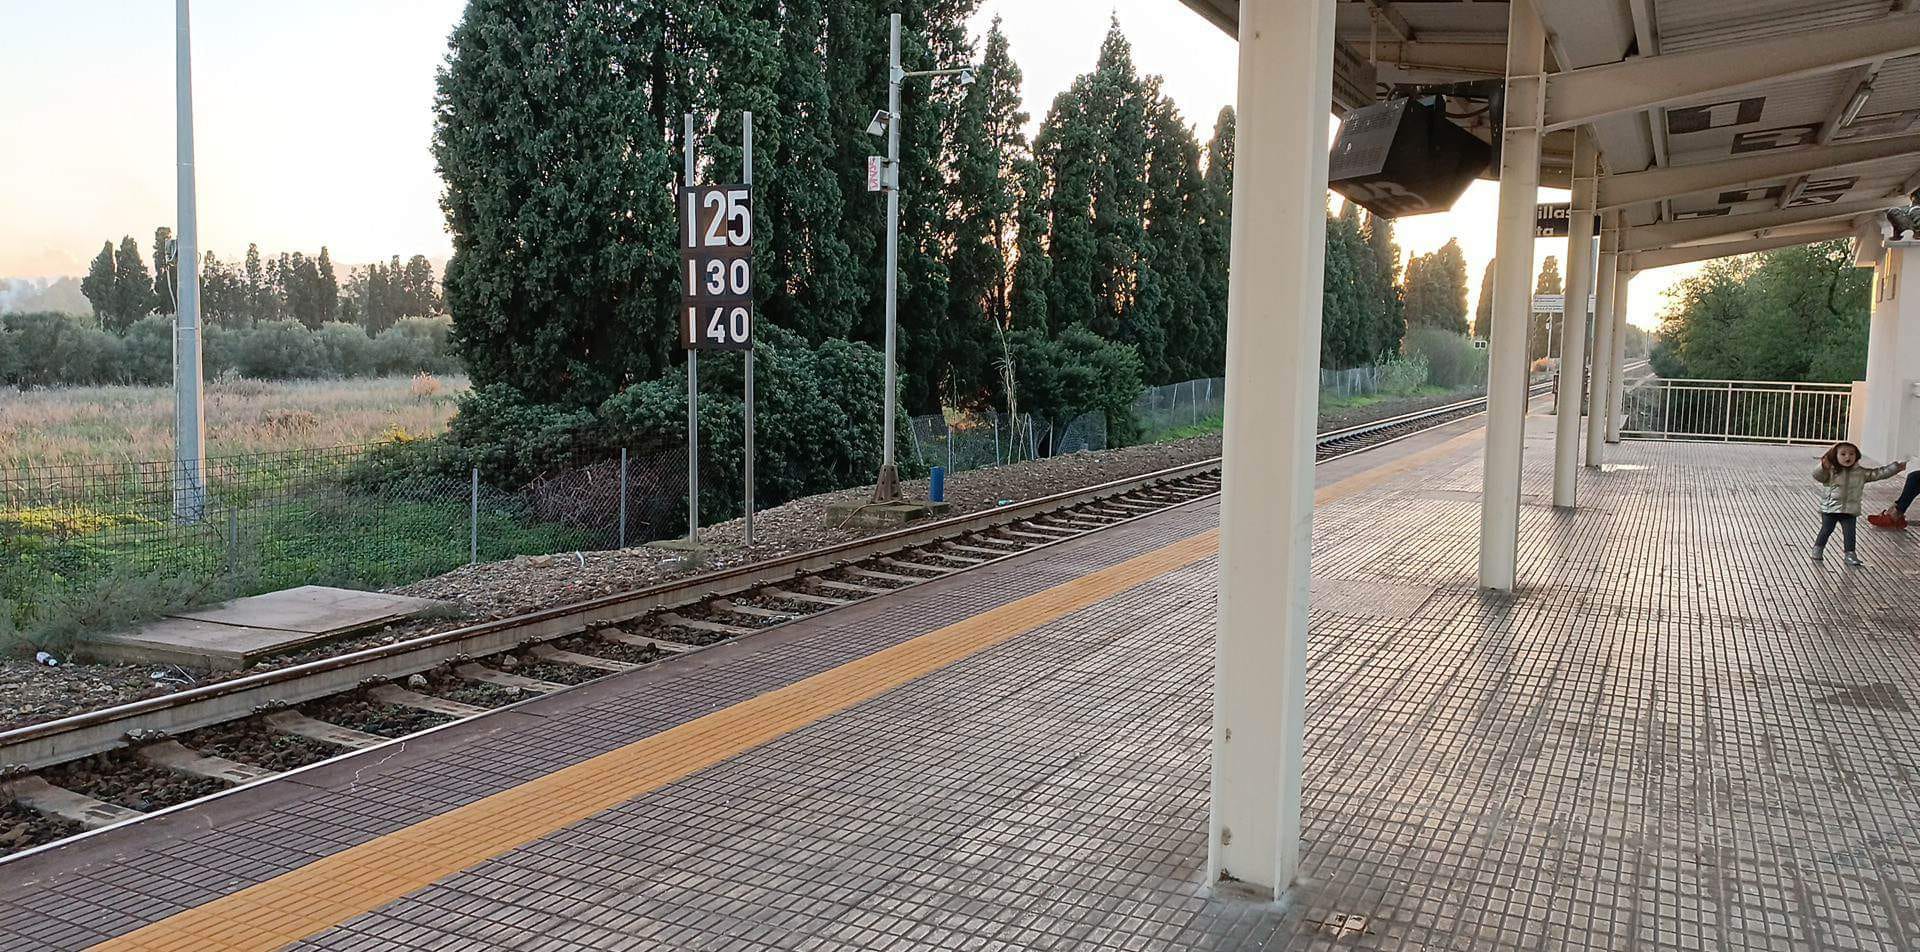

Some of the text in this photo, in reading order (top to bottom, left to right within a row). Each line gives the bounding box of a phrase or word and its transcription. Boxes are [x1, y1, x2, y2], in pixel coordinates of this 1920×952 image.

[688, 190, 750, 247] 125
[1537, 205, 1571, 219] illas
[1536, 226, 1554, 236] ta
[689, 259, 749, 296] 130
[689, 307, 749, 343] 140
